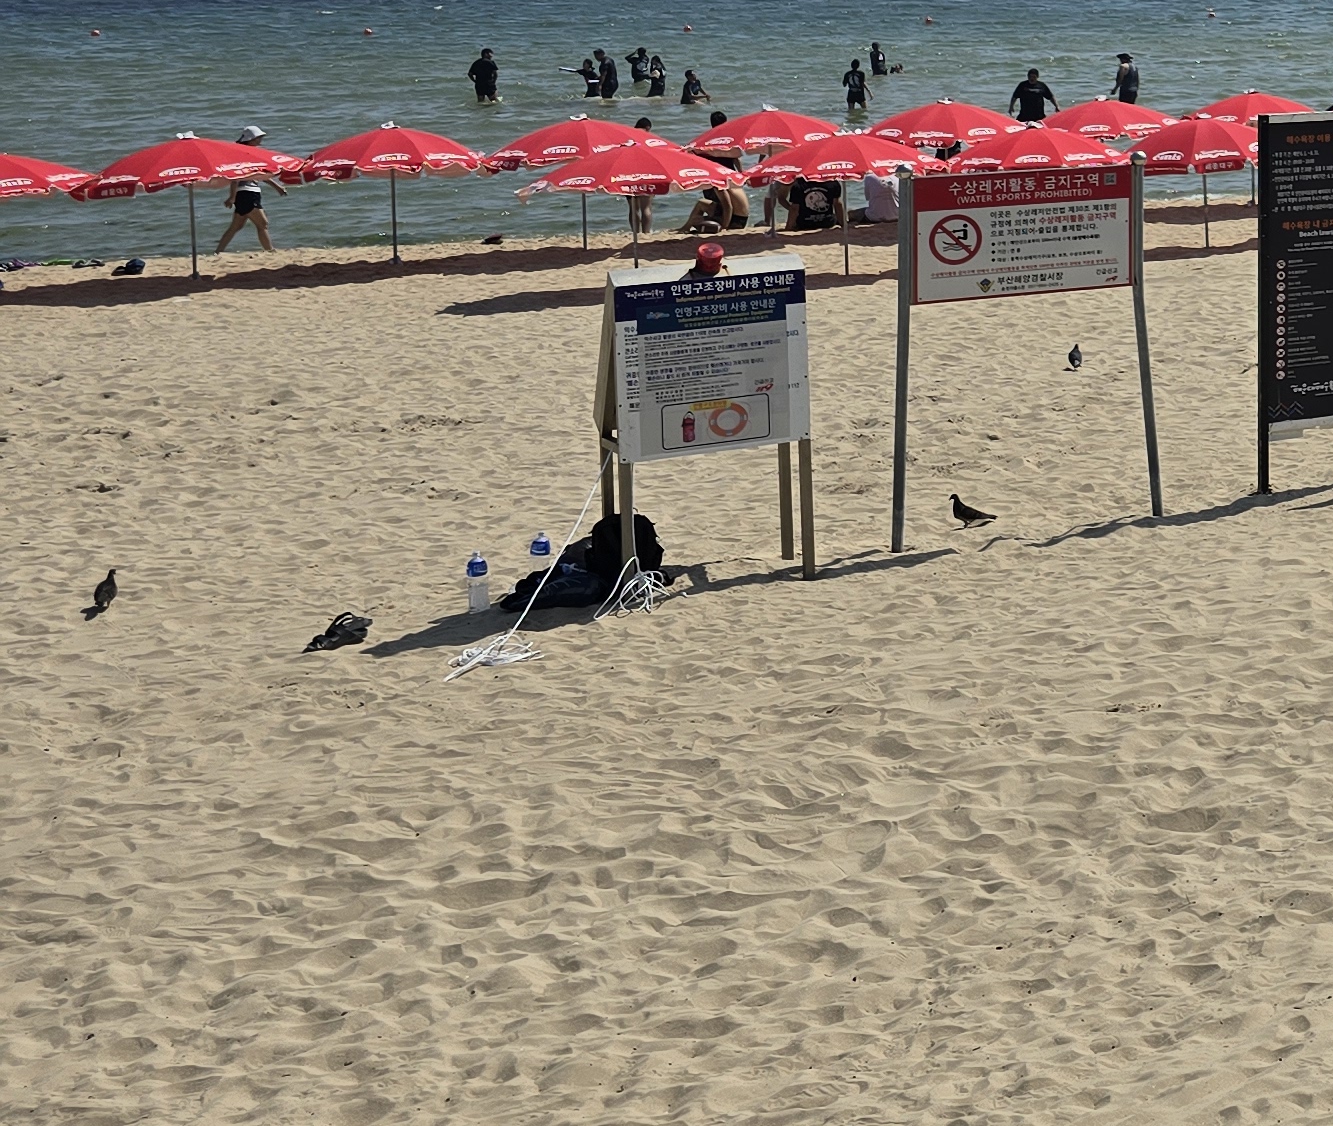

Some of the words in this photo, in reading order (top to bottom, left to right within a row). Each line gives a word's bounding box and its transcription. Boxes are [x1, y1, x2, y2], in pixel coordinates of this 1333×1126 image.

[949, 177, 1037, 196] 수상레저활동
[1043, 173, 1100, 190] 금지구역
[957, 195, 993, 205] (WATER
[996, 193, 1032, 201] SPORTS
[1034, 188, 1093, 199] PROHIBITED)
[990, 210, 1011, 219] 이곳은
[1017, 207, 1066, 218] 수상레저안전법
[990, 220, 1012, 228] 규정에
[1014, 218, 1036, 226] 의하여
[1039, 213, 1085, 225] 수상레저활동
[1087, 211, 1117, 221] 금지구역
[671, 279, 736, 296] 인명구조장비
[739, 277, 761, 289] 사용
[763, 273, 796, 287] 안내문
[997, 272, 1064, 285] 부산해양경찰서장
[675, 303, 728, 318] 인명구조장비
[730, 301, 748, 312] 사용
[750, 298, 777, 310] 안내문
